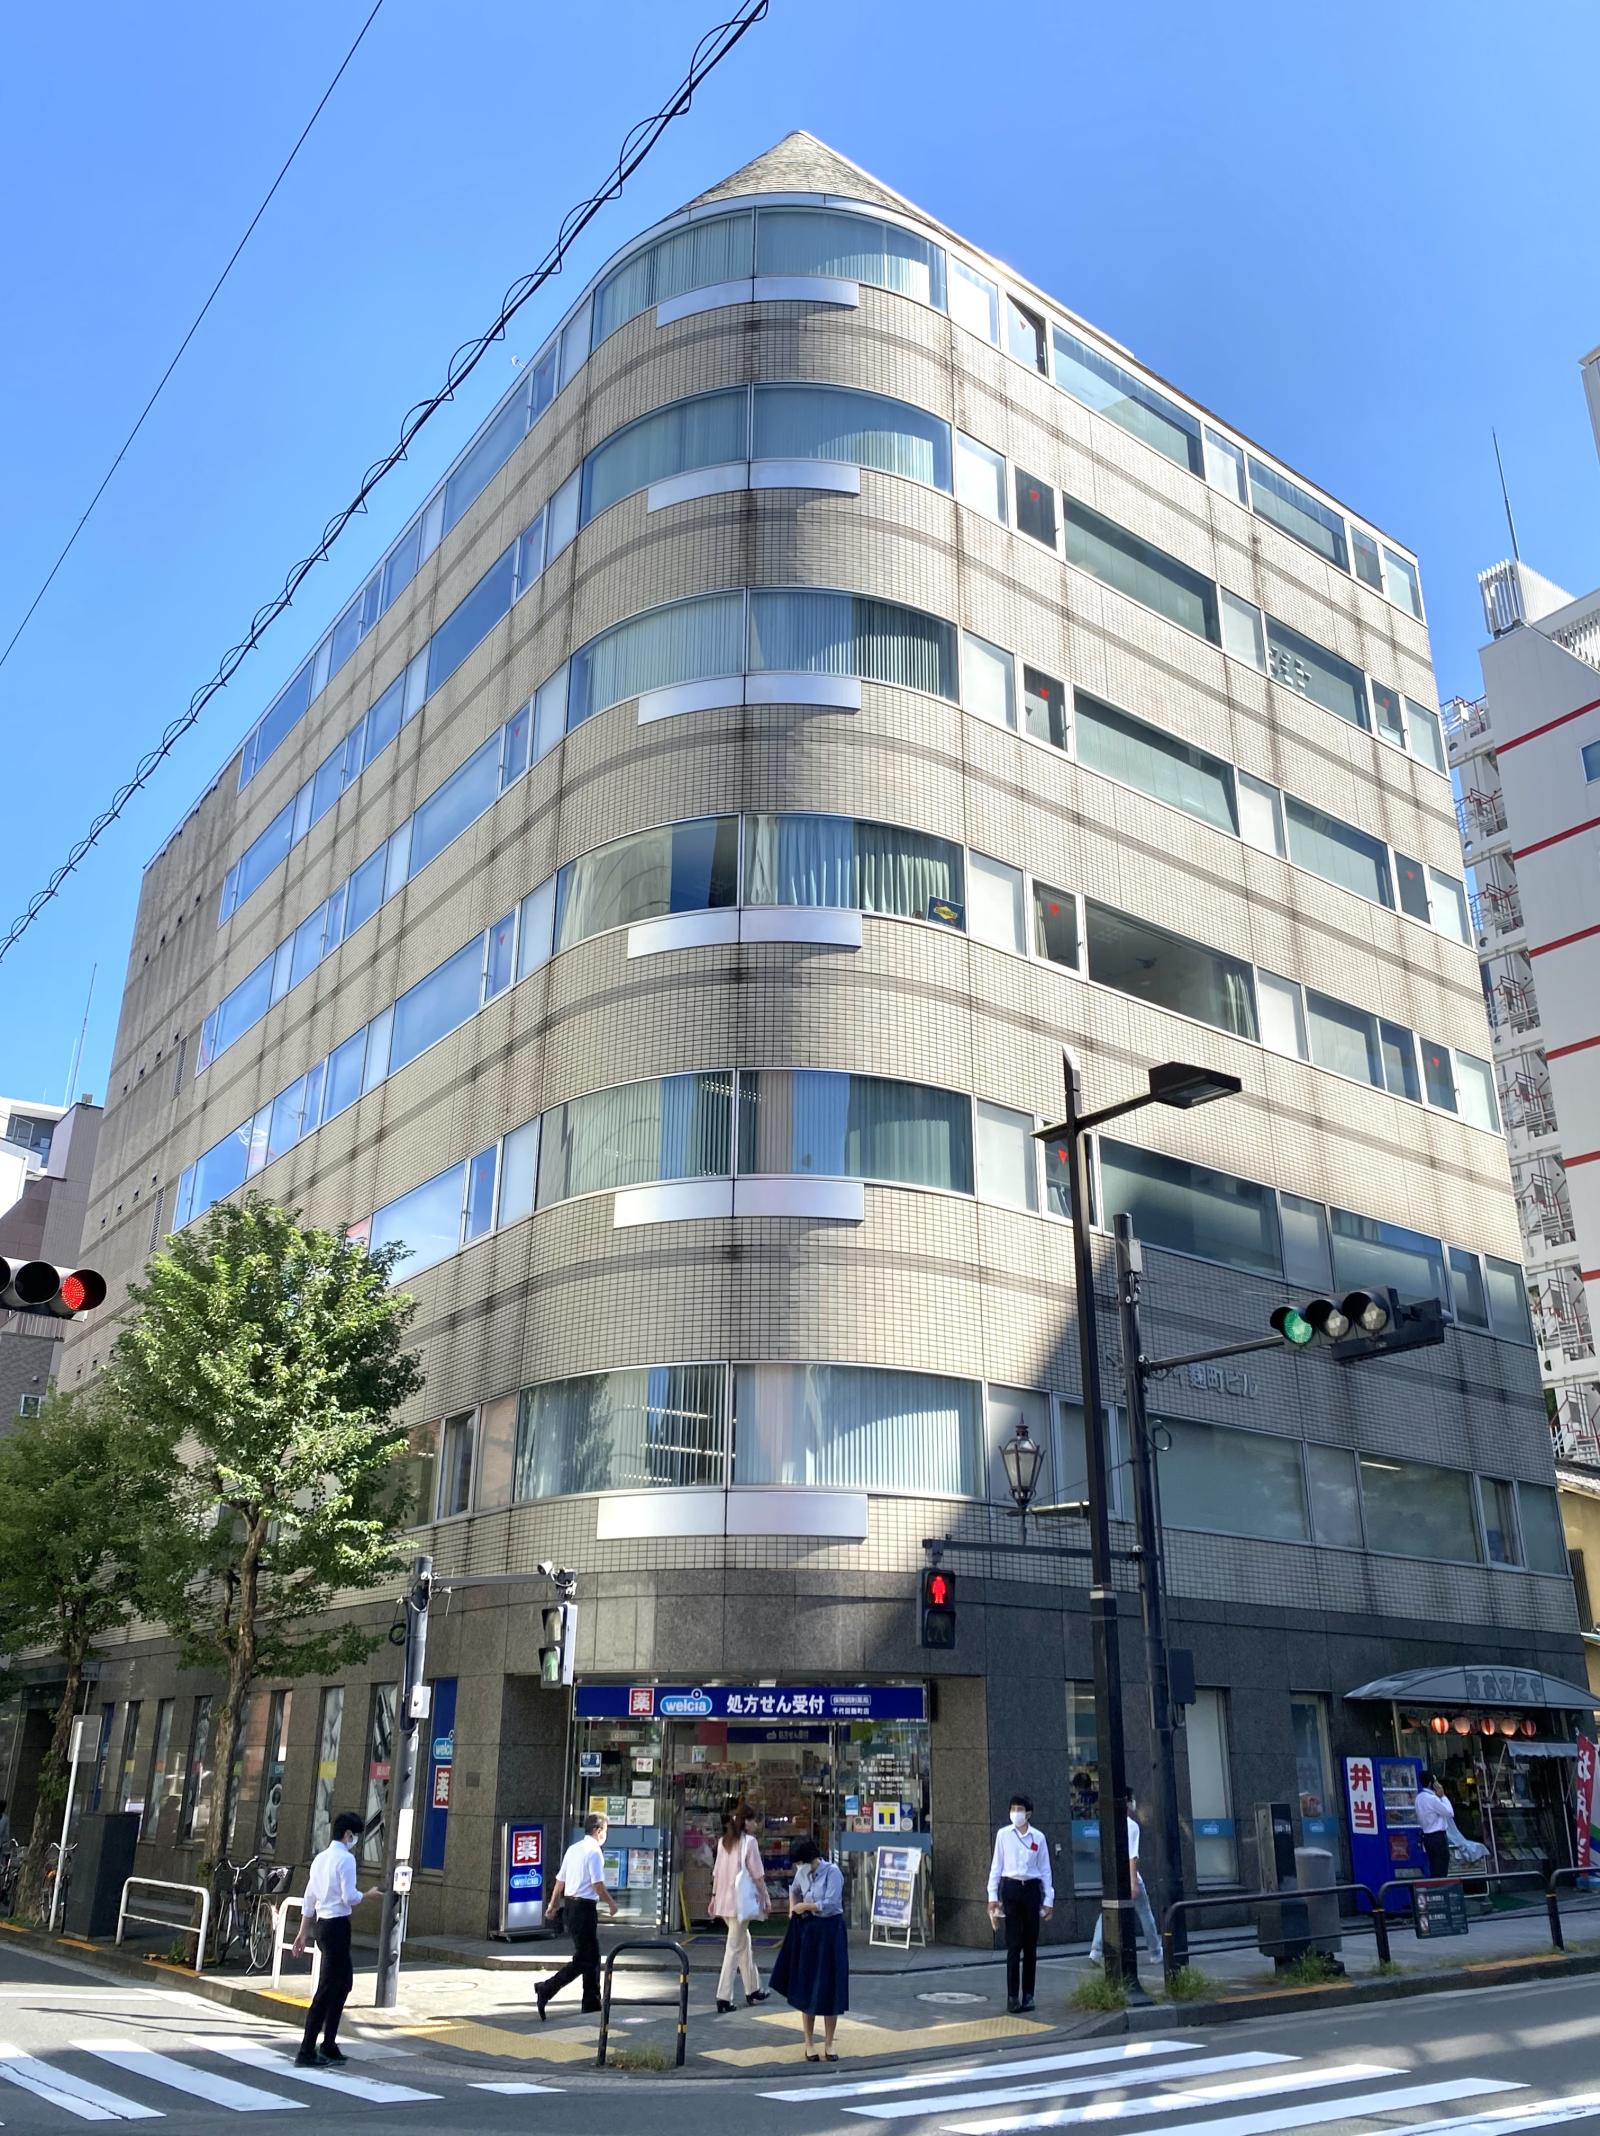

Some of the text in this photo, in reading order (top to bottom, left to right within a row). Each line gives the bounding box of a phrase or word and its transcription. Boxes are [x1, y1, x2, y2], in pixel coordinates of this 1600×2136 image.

[632, 1692, 650, 1711] 薬
[665, 1689, 707, 1712] welcia
[727, 1694, 824, 1714] 処方せん受付
[1350, 1763, 1375, 1829] 弁当
[517, 1836, 537, 1860] 薬
